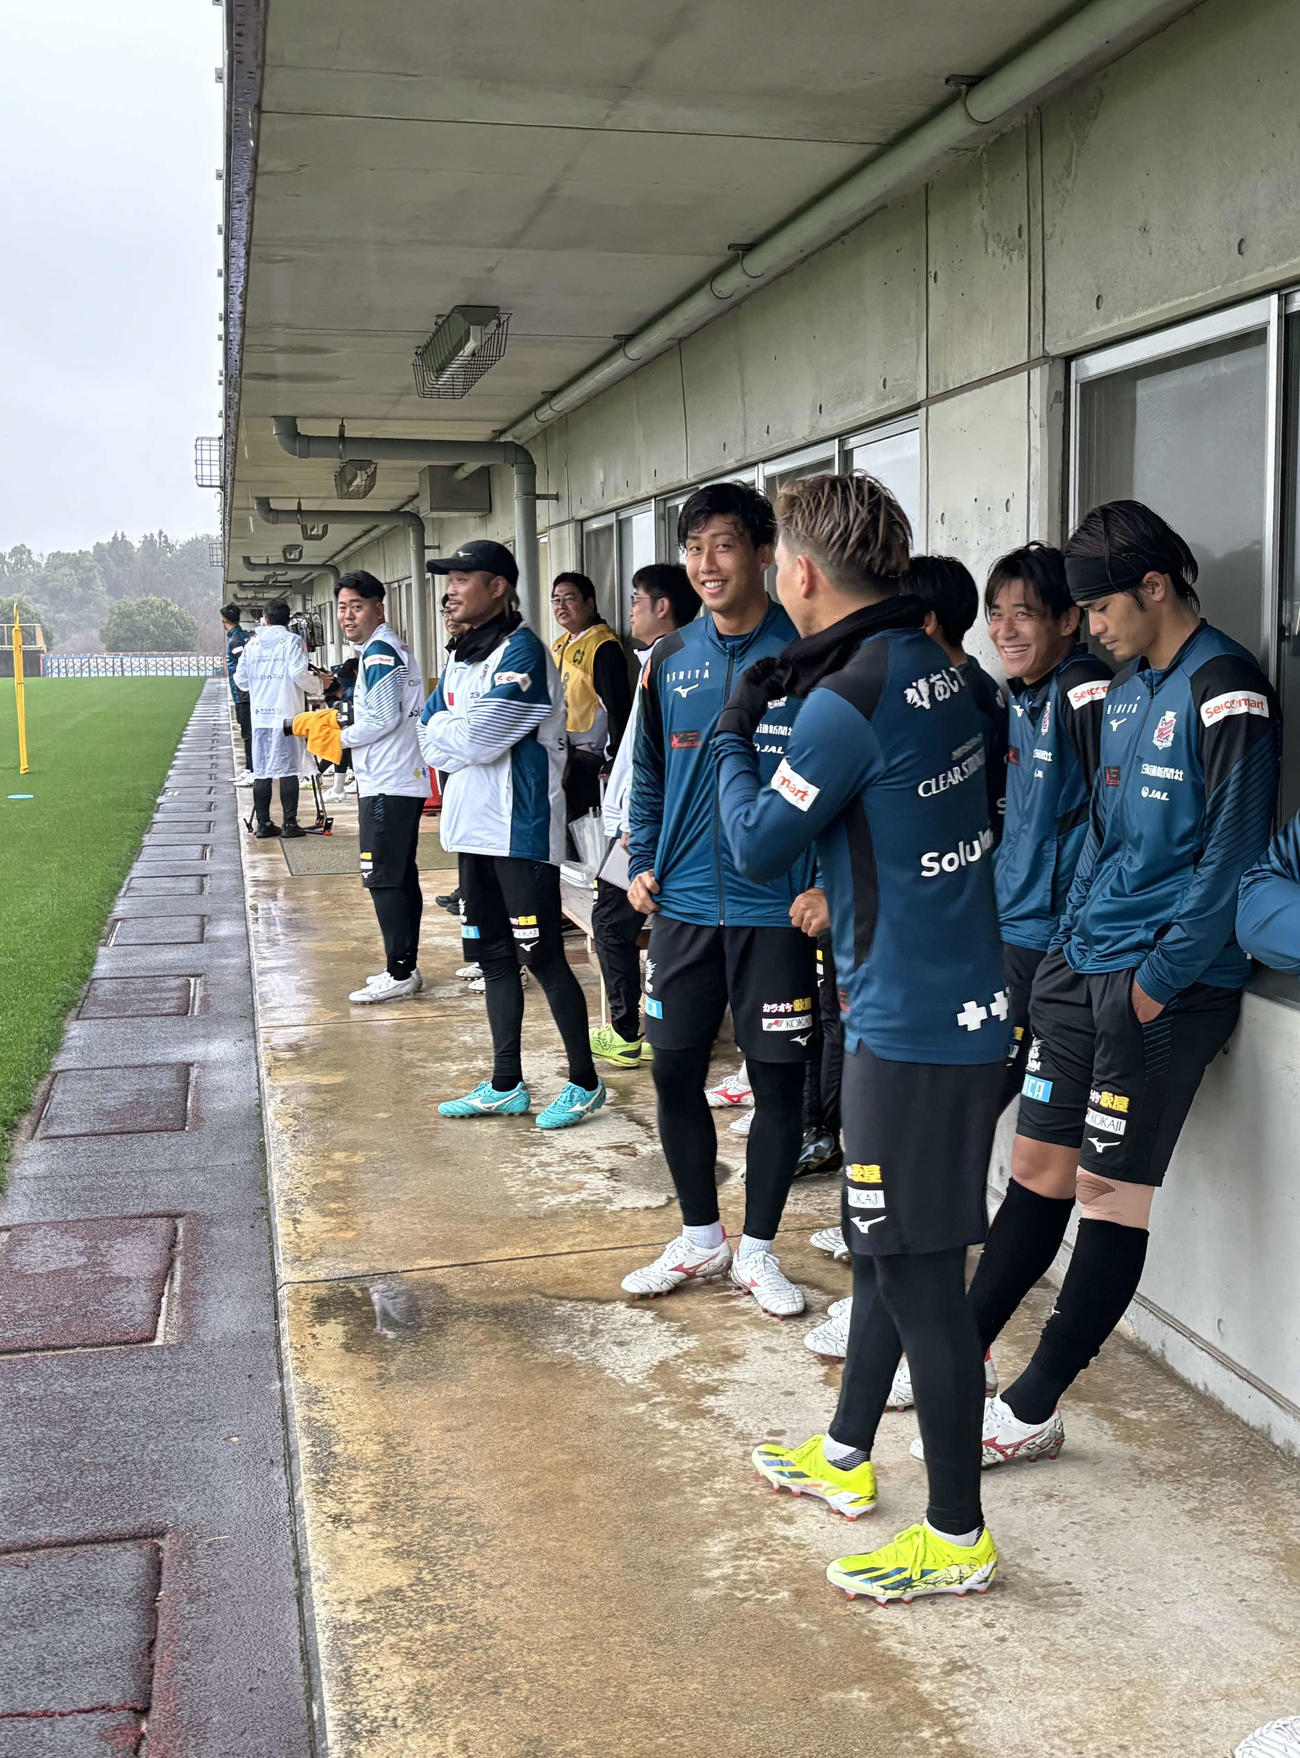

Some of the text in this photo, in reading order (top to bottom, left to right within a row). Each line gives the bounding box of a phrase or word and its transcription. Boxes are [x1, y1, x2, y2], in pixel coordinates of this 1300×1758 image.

[760, 745, 785, 754] JAL
[918, 766, 964, 797] CLEAR
[1148, 789, 1170, 801] JAL
